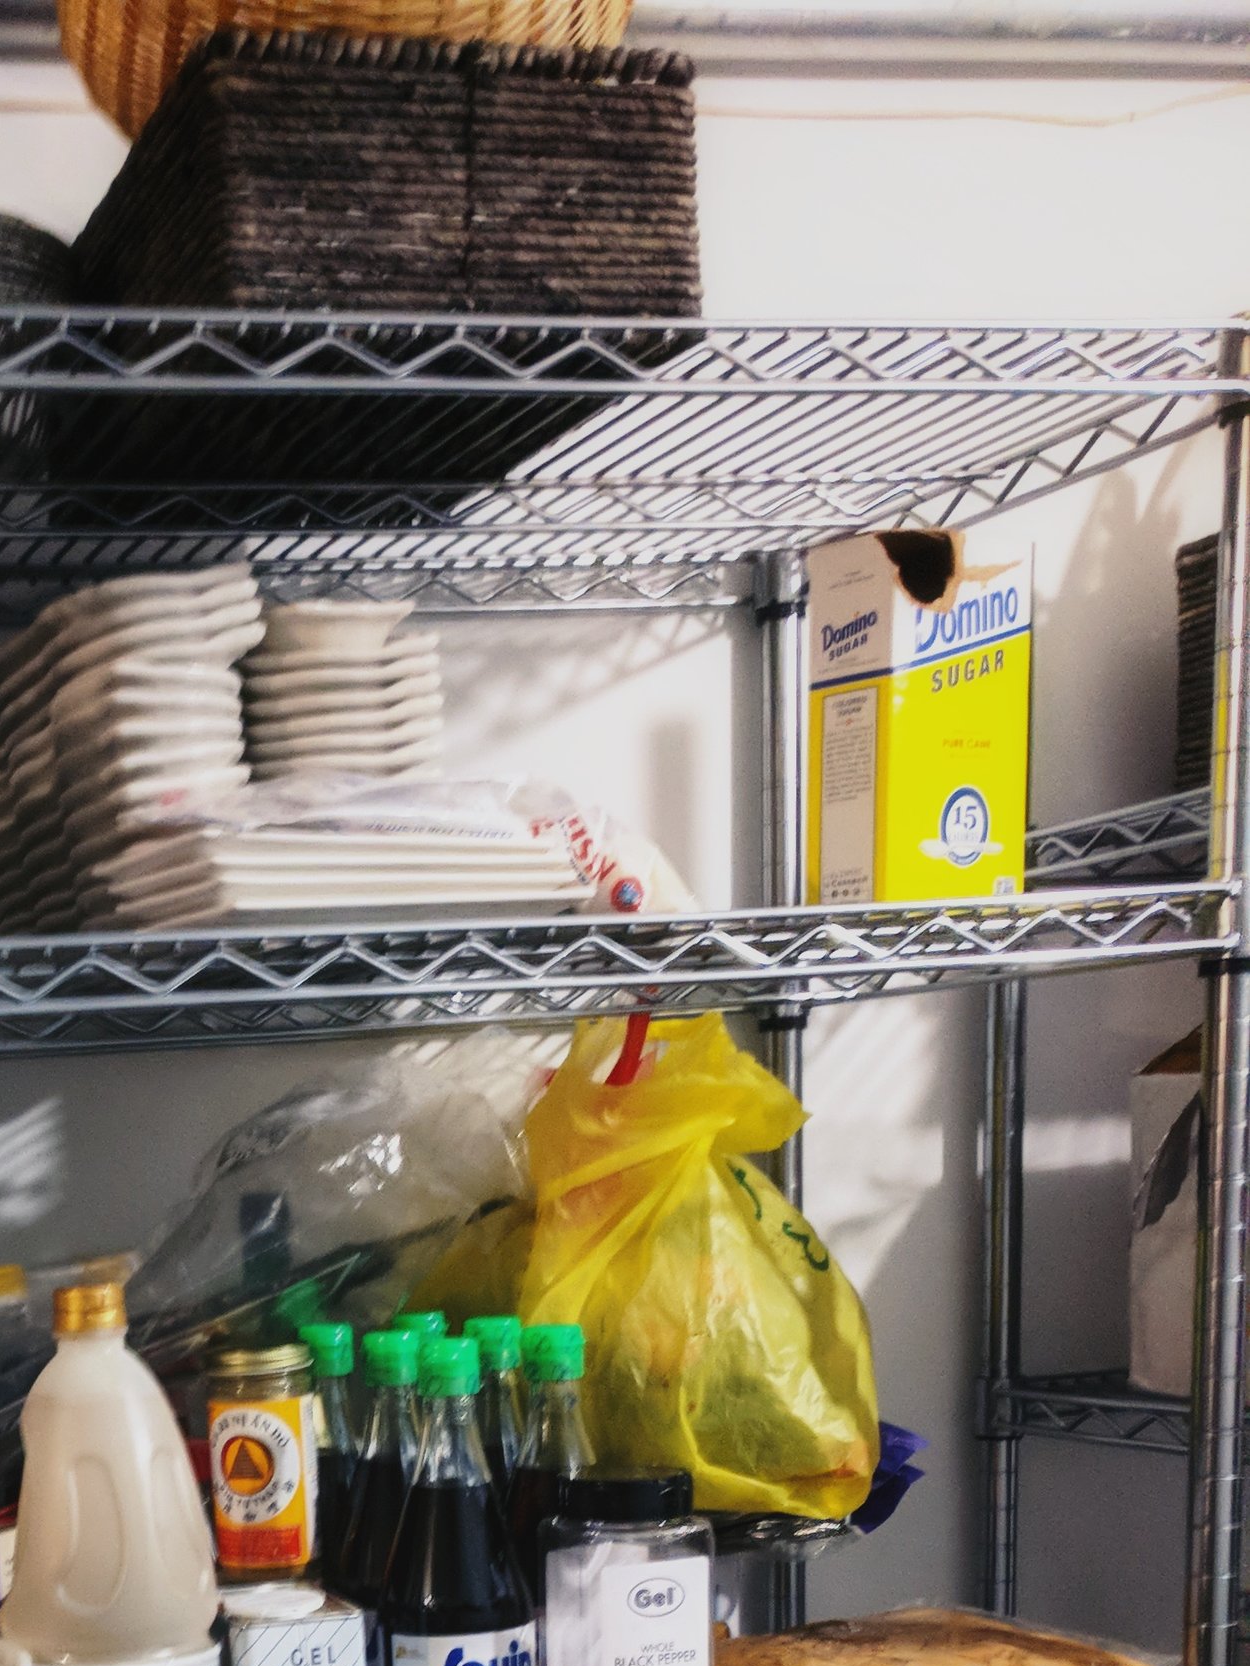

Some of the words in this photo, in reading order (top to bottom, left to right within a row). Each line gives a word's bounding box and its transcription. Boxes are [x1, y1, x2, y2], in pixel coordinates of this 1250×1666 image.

[821, 611, 878, 651] Domino
[915, 587, 1019, 653] Domino
[828, 634, 868, 662] SUGAR
[931, 649, 1005, 693] SUGAR
[952, 804, 978, 831] 15
[634, 1587, 674, 1609] Gel
[641, 1641, 674, 1654] WHOLE
[657, 1649, 697, 1666] PEPPER
